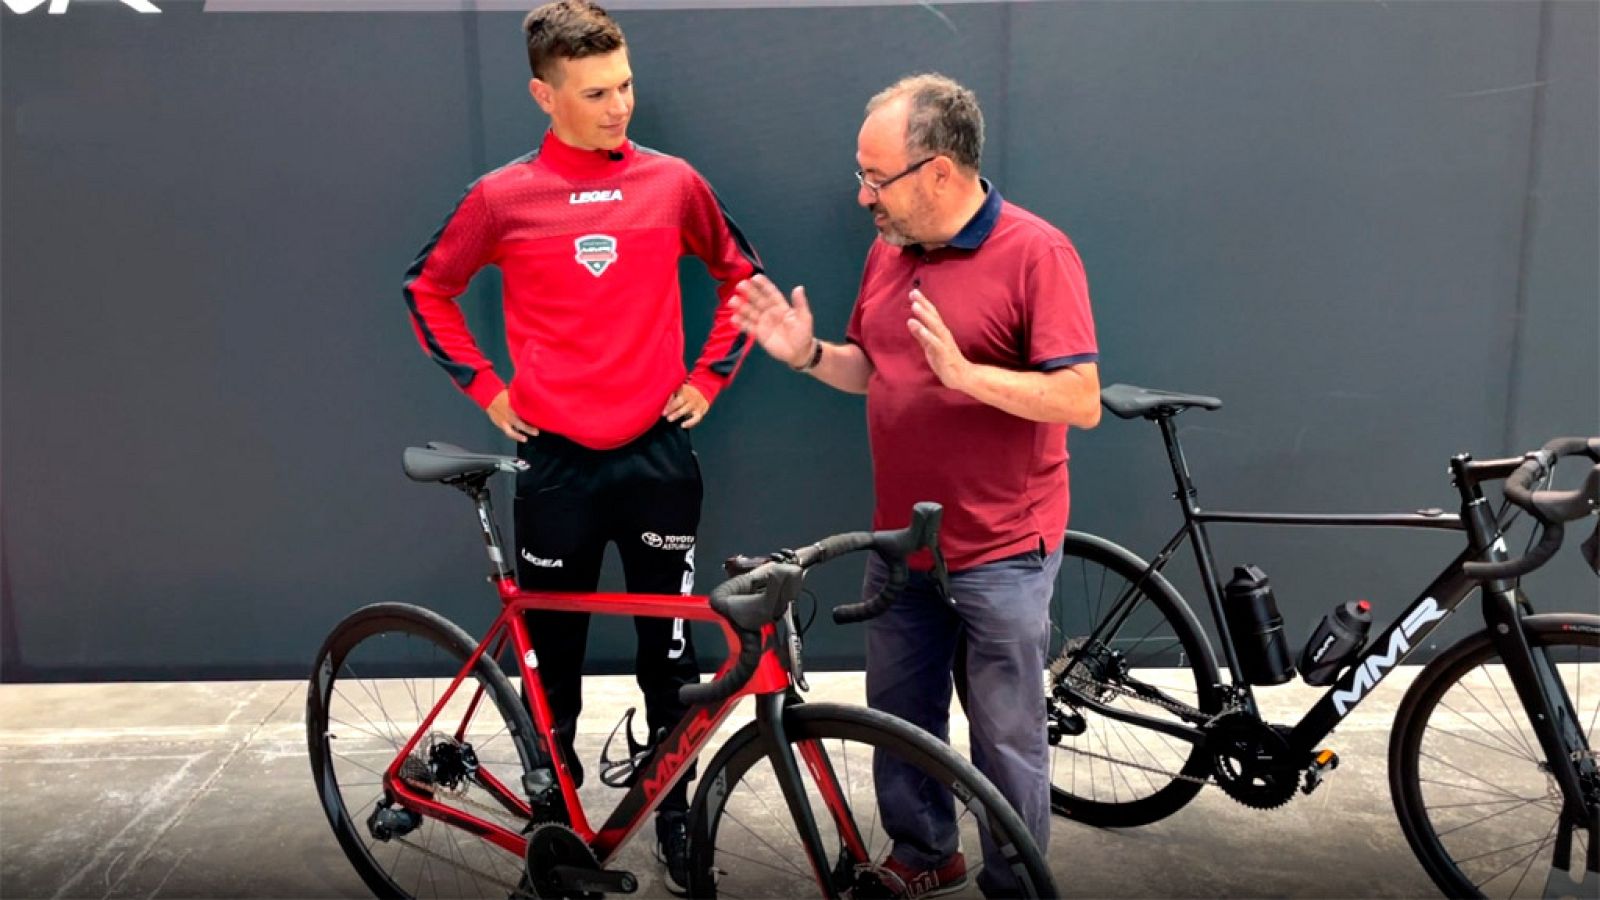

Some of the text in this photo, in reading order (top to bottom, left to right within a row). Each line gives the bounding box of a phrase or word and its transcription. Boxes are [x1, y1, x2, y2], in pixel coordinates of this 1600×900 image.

[569, 189, 623, 204] LEGEA
[521, 546, 564, 568] LEGEA
[1332, 596, 1448, 716] MMR
[642, 709, 714, 798] MMR
